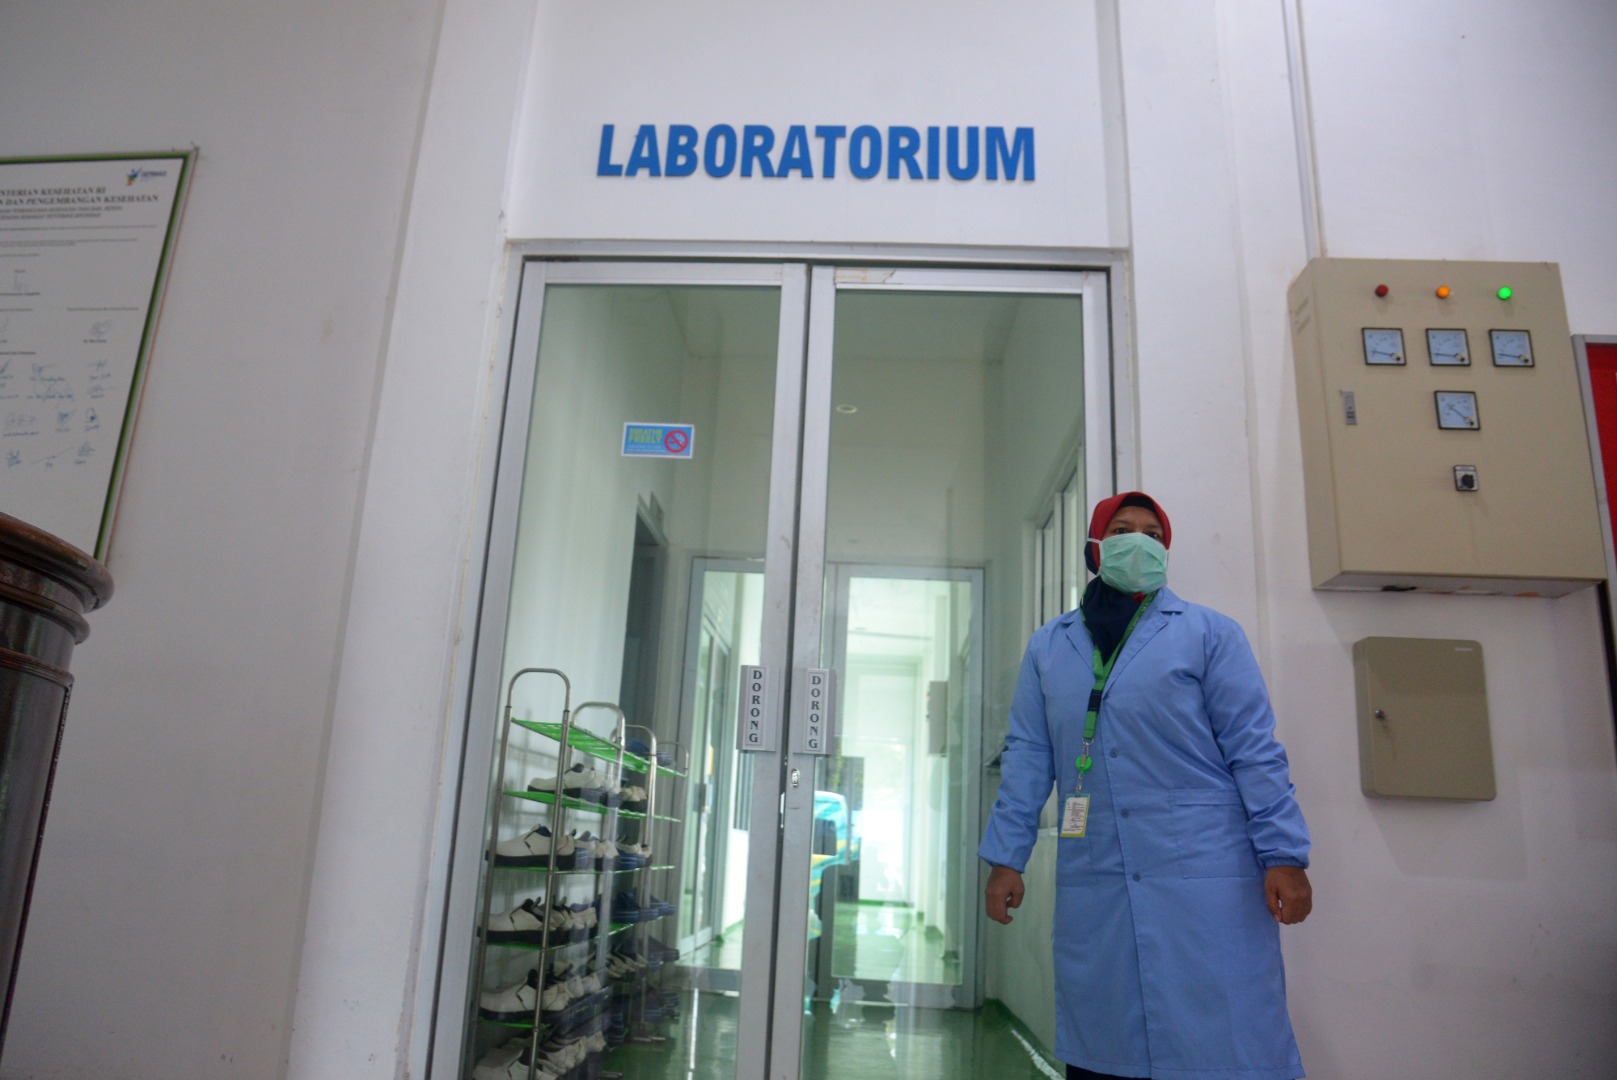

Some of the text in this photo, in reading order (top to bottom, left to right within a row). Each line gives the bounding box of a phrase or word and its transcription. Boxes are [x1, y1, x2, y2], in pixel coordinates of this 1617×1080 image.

[597, 124, 1036, 181] LABORATORIUM
[104, 194, 159, 203] KESEHATAN
[748, 670, 762, 743] DORONG
[808, 675, 821, 749] DORONG
